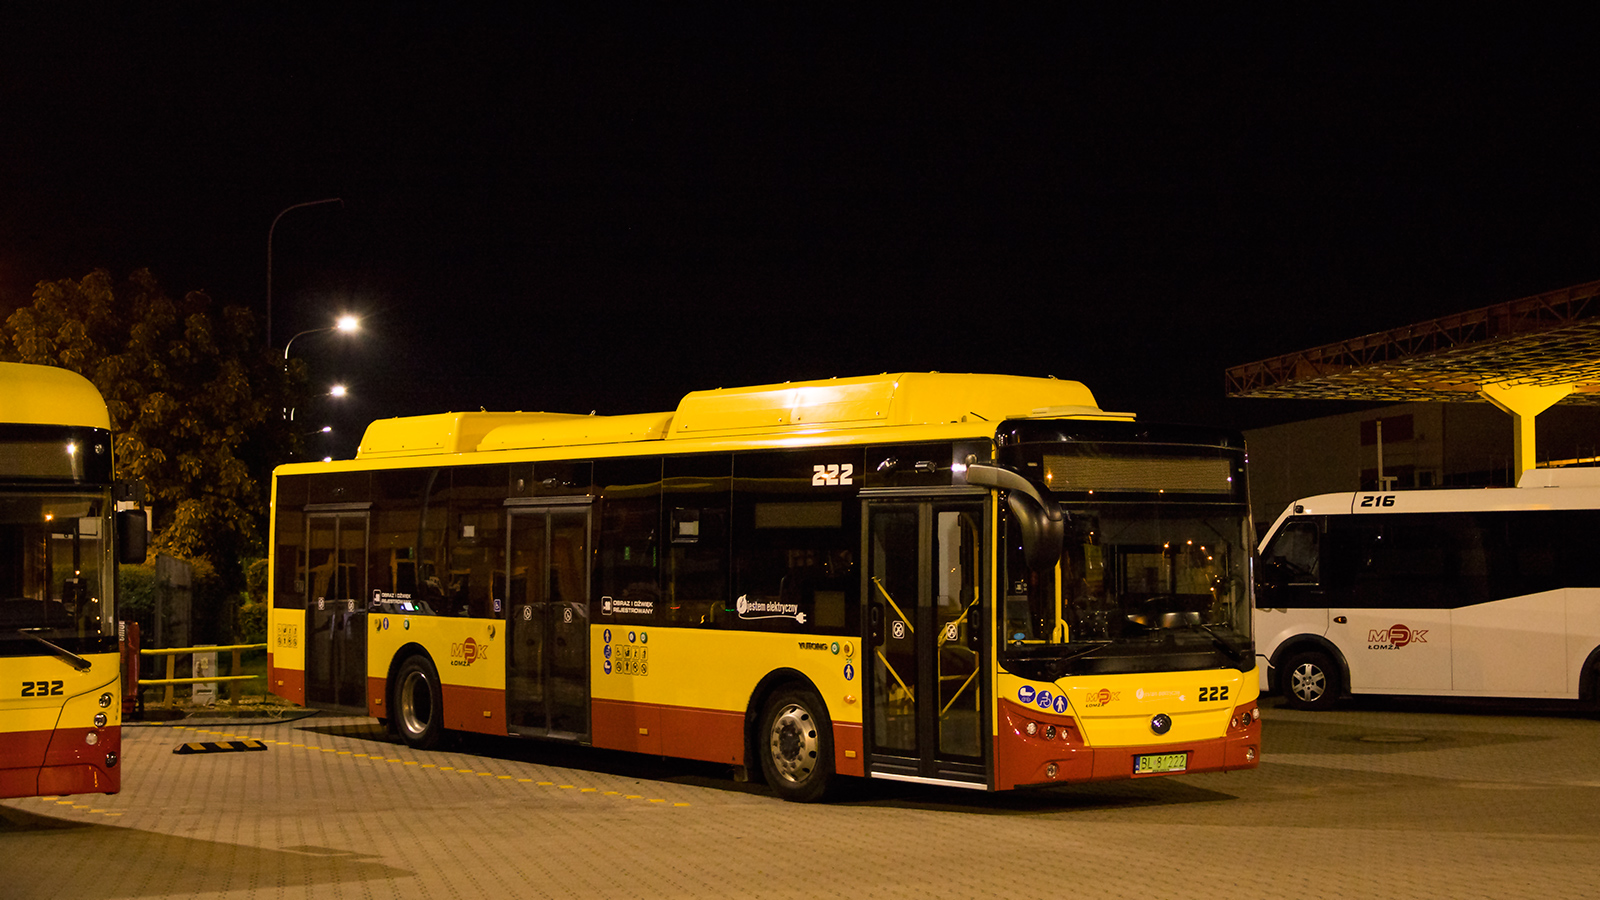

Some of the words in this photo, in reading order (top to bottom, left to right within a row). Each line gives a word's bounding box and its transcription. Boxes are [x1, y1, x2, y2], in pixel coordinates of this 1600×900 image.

[812, 463, 854, 486] 222
[1360, 495, 1396, 507] 216
[747, 601, 766, 613] jestem
[767, 601, 798, 614] elektryczny
[1368, 626, 1429, 647] MPK
[451, 638, 488, 662] MPK
[798, 642, 828, 650] YUTONG
[21, 680, 64, 697] 232
[1085, 689, 1121, 703] MPK
[1198, 686, 1229, 702] 222
[1141, 757, 1153, 769] BL
